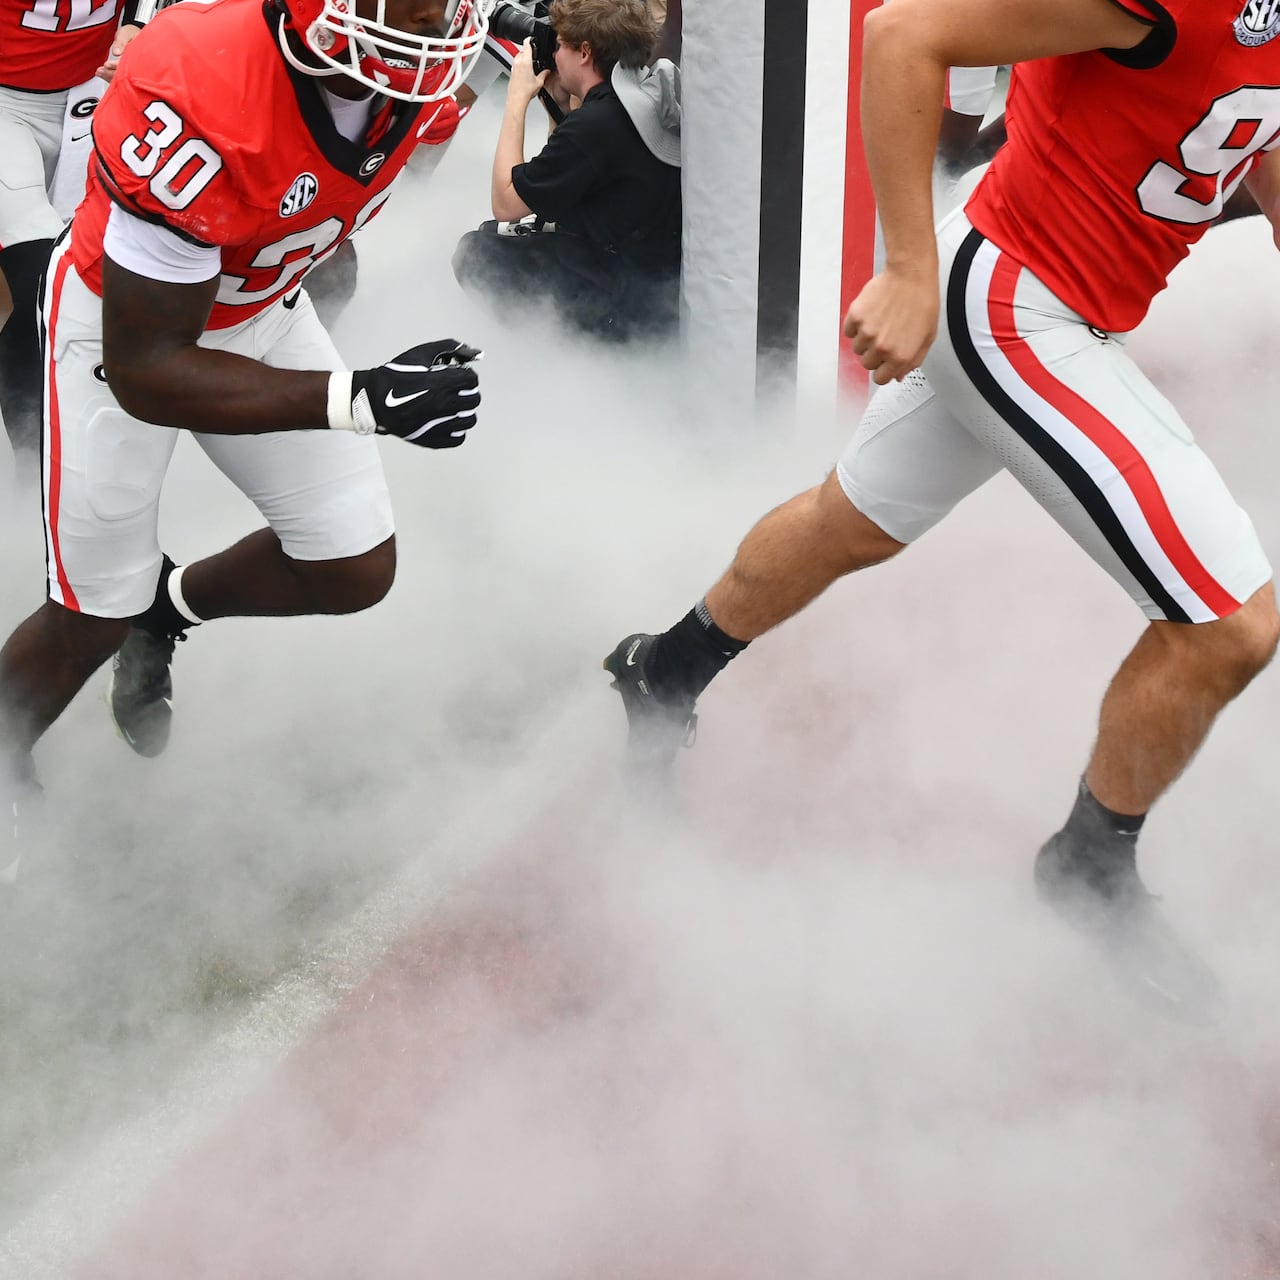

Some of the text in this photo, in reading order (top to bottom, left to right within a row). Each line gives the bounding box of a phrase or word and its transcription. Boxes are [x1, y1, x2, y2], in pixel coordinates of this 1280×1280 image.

[71, 97, 100, 117] G
[120, 100, 224, 210] 30
[281, 173, 317, 216] SEC
